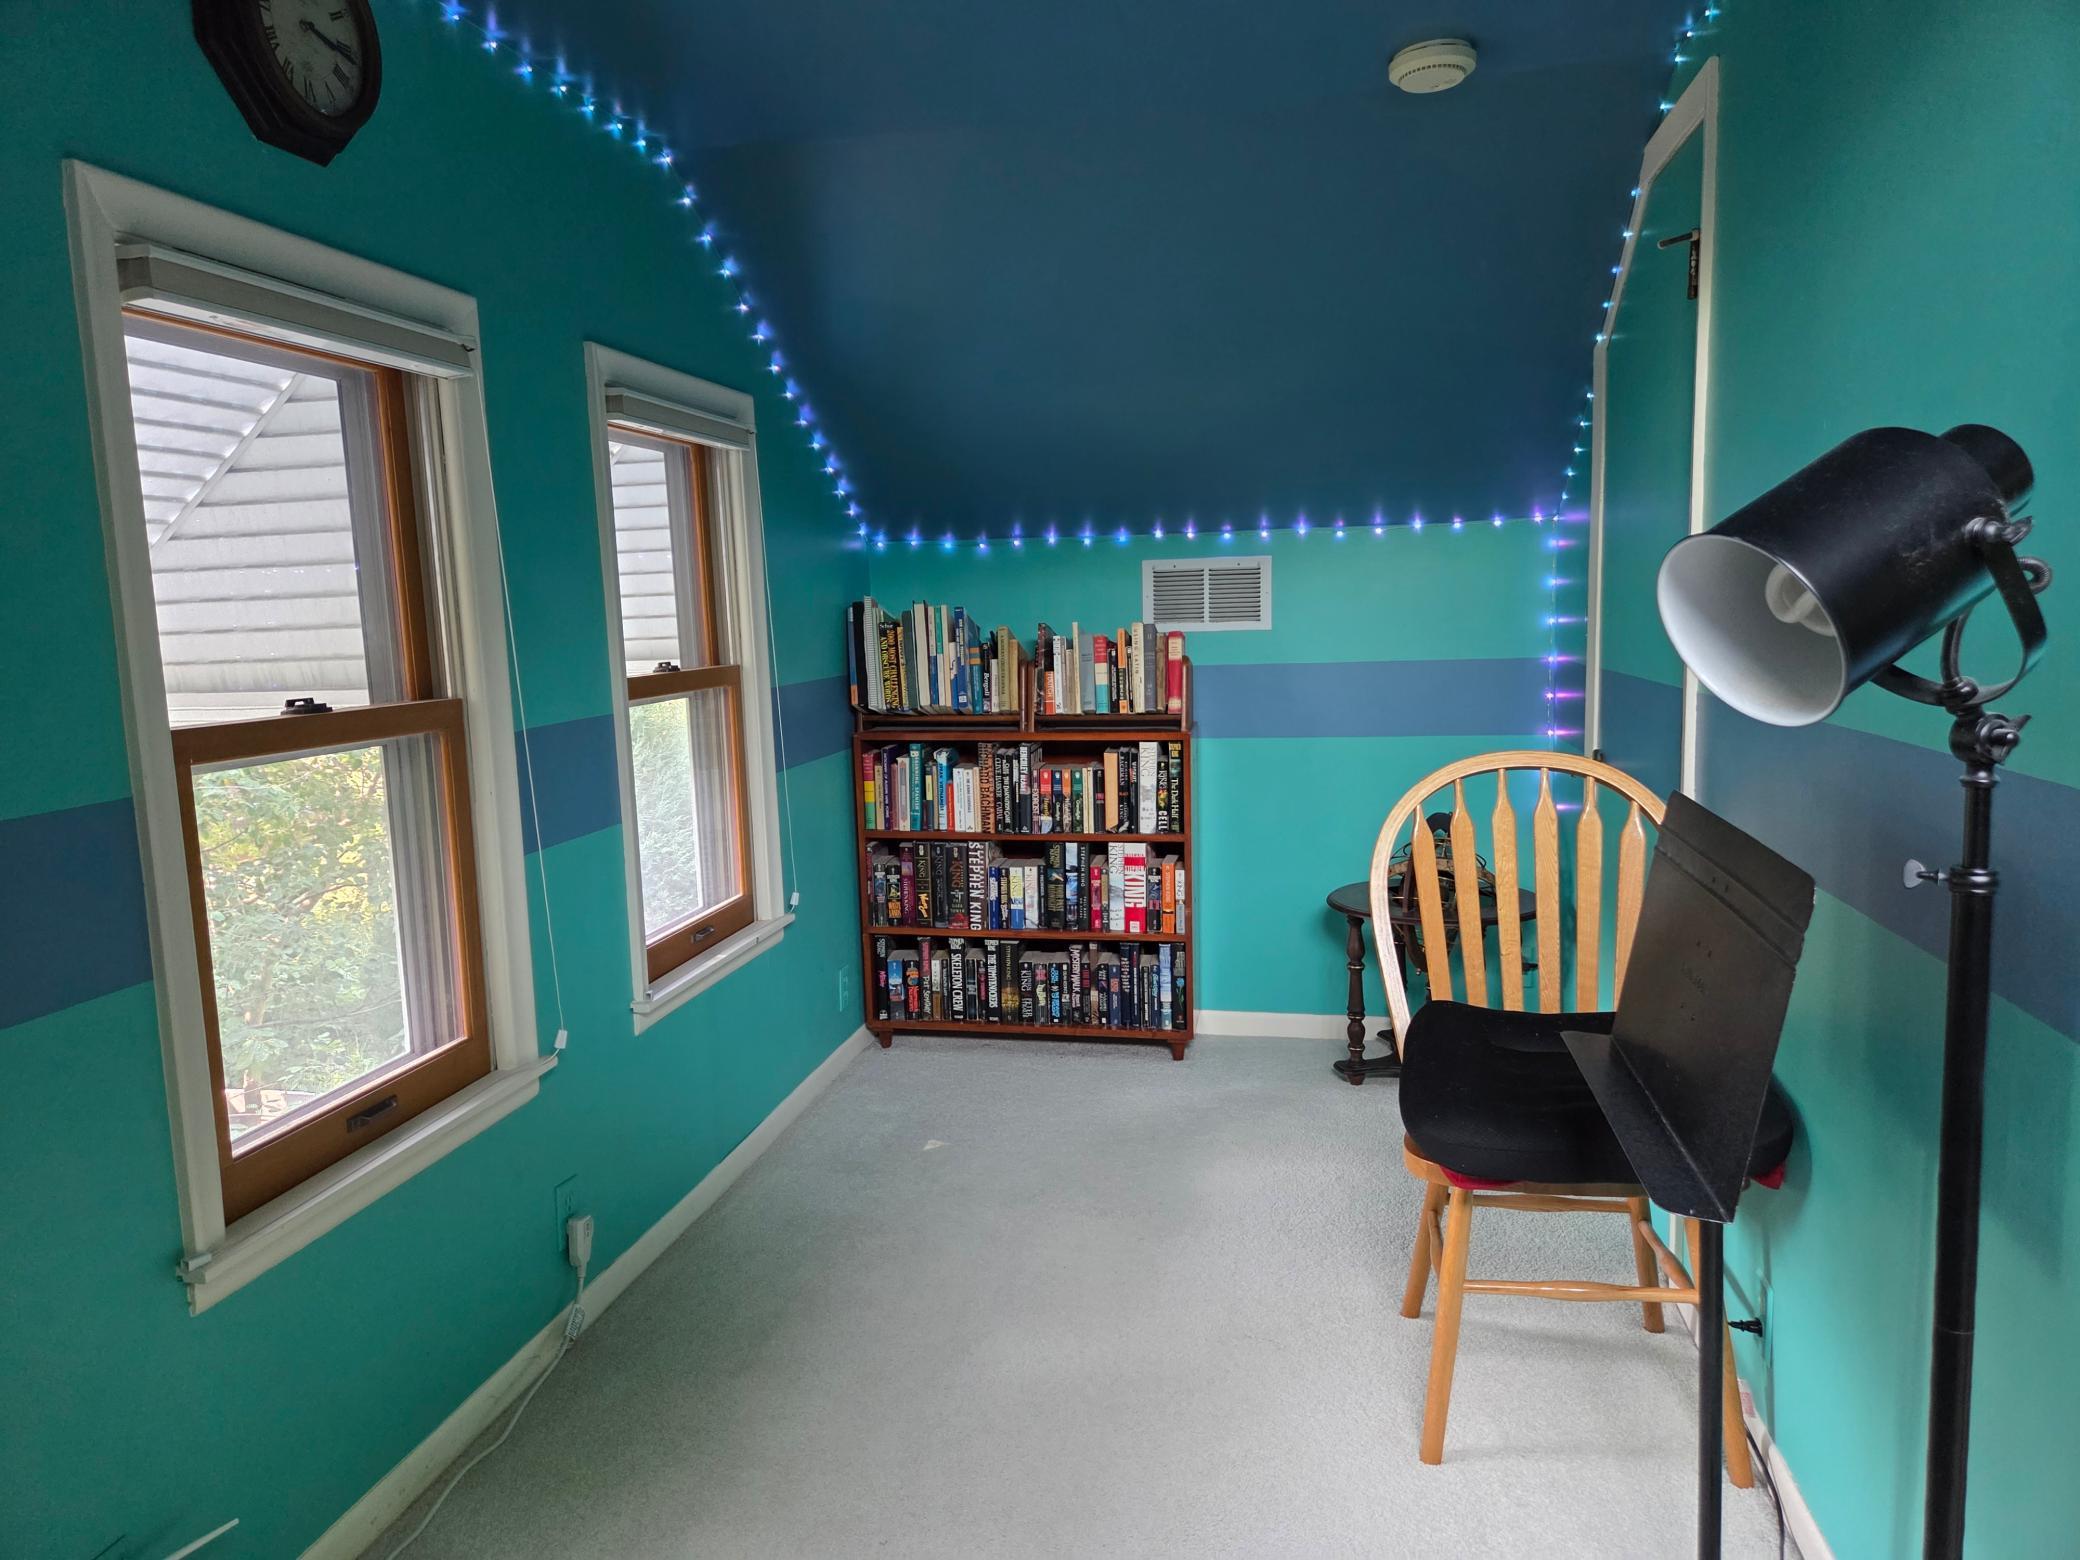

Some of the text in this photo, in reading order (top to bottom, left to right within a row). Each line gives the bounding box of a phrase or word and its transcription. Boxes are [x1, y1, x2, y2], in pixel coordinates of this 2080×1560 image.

[983, 673, 991, 697] Bengali
[1020, 747, 1028, 774] BENCHLEY
[1141, 748, 1149, 777] KING
[981, 787, 991, 833] BACHMAN
[1158, 770, 1167, 830] KING CELL
[1171, 790, 1179, 804] Dark
[917, 859, 927, 879] KING
[1109, 846, 1117, 875] KING
[950, 863, 962, 888] KING
[969, 841, 982, 931] STEPHEN KING
[1125, 872, 1145, 908] KING
[952, 953, 964, 1011] SKELETON CREW
[988, 954, 998, 1008] THE TOMMYKNOCKERS
[1071, 974, 1081, 992] WALK
